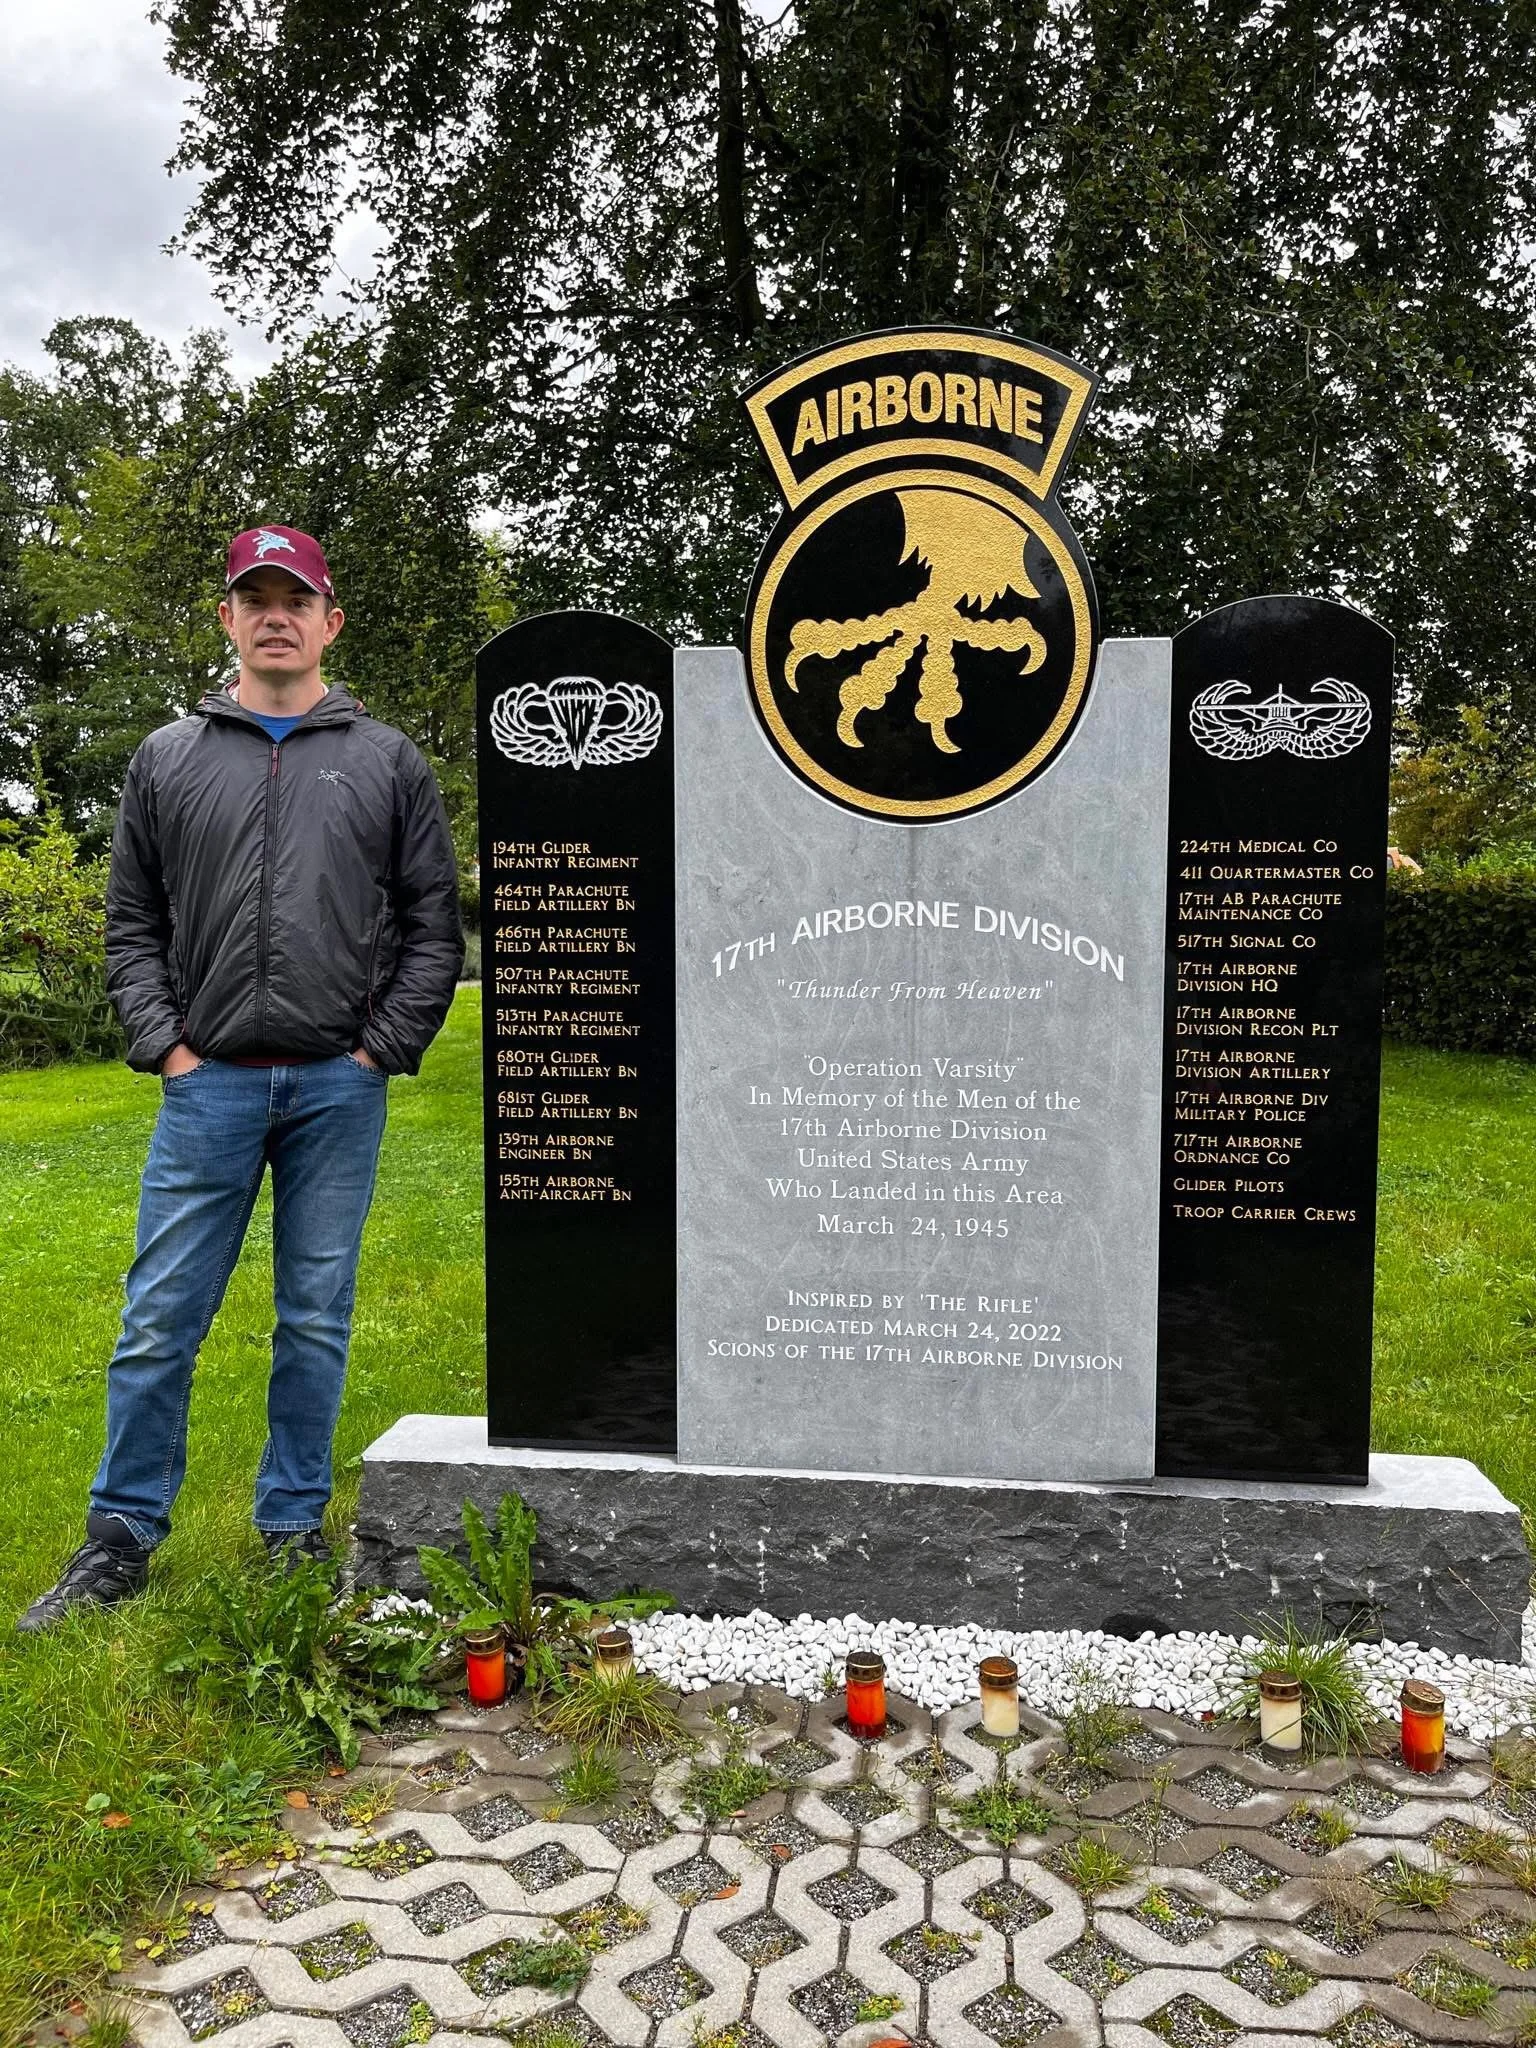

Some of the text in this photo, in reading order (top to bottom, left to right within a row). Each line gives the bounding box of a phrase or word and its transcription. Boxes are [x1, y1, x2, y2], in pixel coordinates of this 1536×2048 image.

[791, 371, 1044, 456] AIRBORNE
[1180, 866, 1201, 879] 411
[710, 900, 1125, 982] 17TH AIRBORNE DIVISION
[776, 978, 1054, 1002] "Thunder From Heaven"
[803, 1055, 1025, 1083] "Operation Varsity"
[749, 1085, 1081, 1111] In Memory of the Men of the
[779, 1118, 1048, 1141] 17th Airborne Division
[798, 1148, 1029, 1176] United States Army
[765, 1178, 1063, 1205] Who Landed in this Area
[817, 1213, 1010, 1240] March 24, 1945
[1008, 1323, 1062, 1342] 2022
